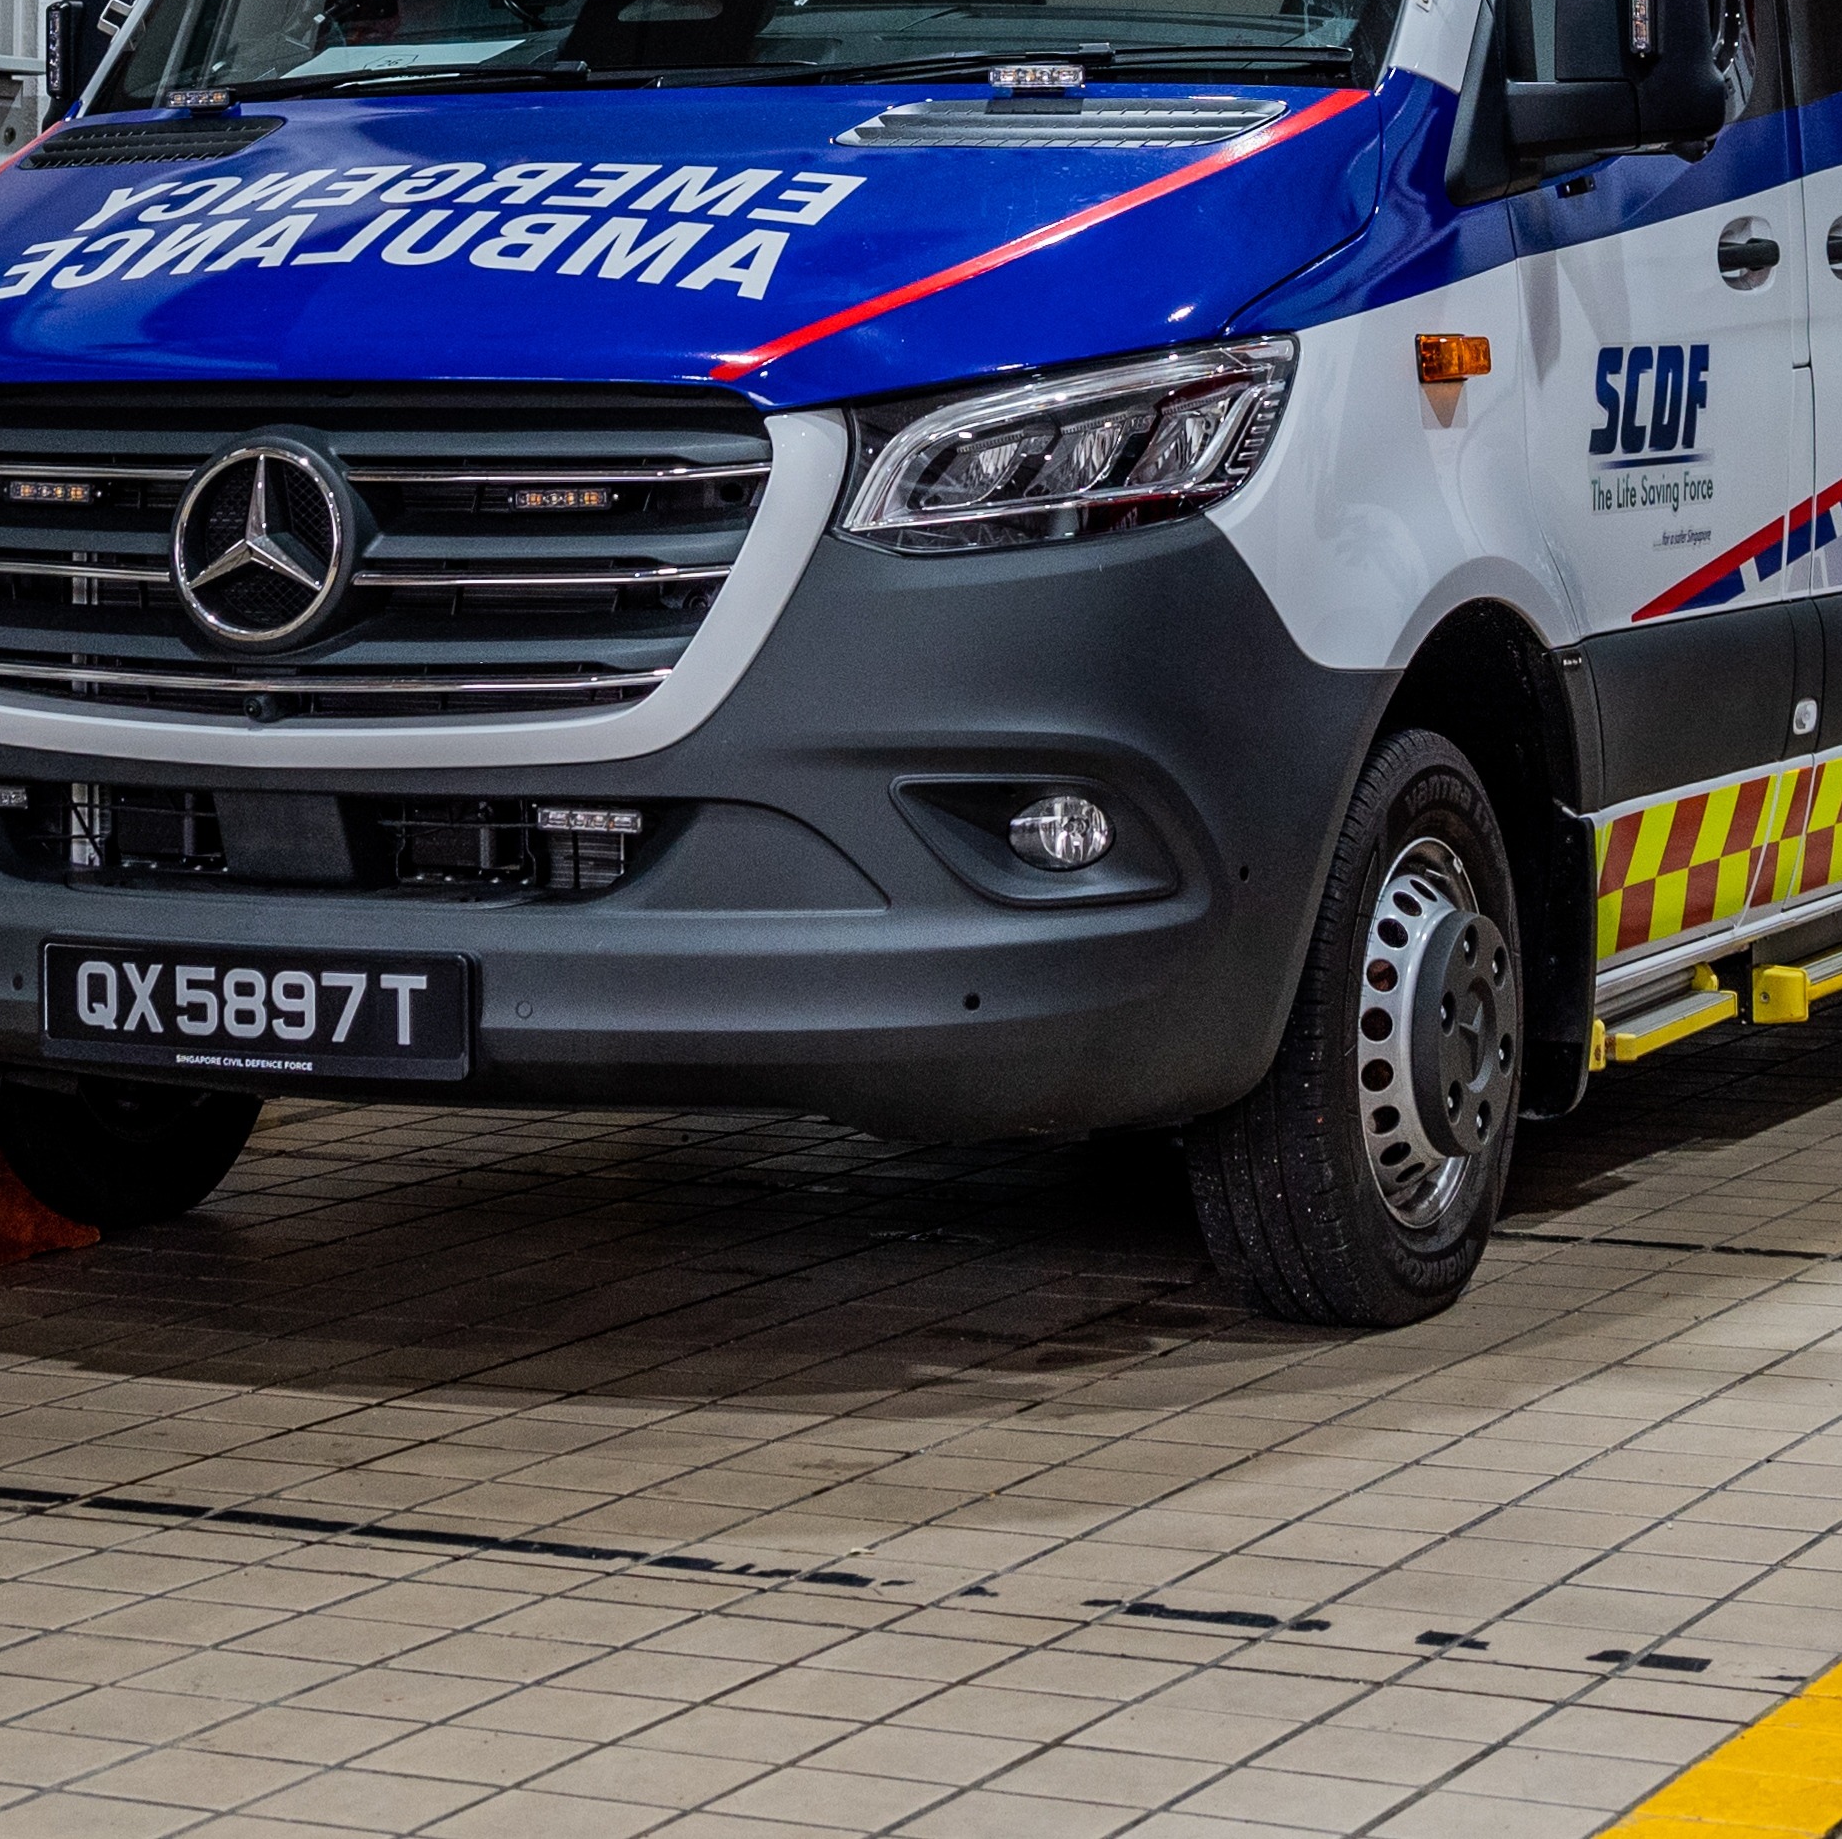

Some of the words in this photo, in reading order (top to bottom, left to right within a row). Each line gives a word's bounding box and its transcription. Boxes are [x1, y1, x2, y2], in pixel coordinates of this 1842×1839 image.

[1589, 344, 1710, 455] SCDF
[1591, 476, 1612, 511] The
[1616, 473, 1636, 509] Life
[1641, 474, 1679, 511] Saving
[1683, 471, 1713, 502] Force
[77, 961, 427, 1045] QX5897T
[176, 1054, 221, 1065] SINGAPORE
[223, 1057, 243, 1067] CIVIL
[245, 1059, 282, 1069] DEFENCE
[284, 1061, 312, 1071] FORCE
